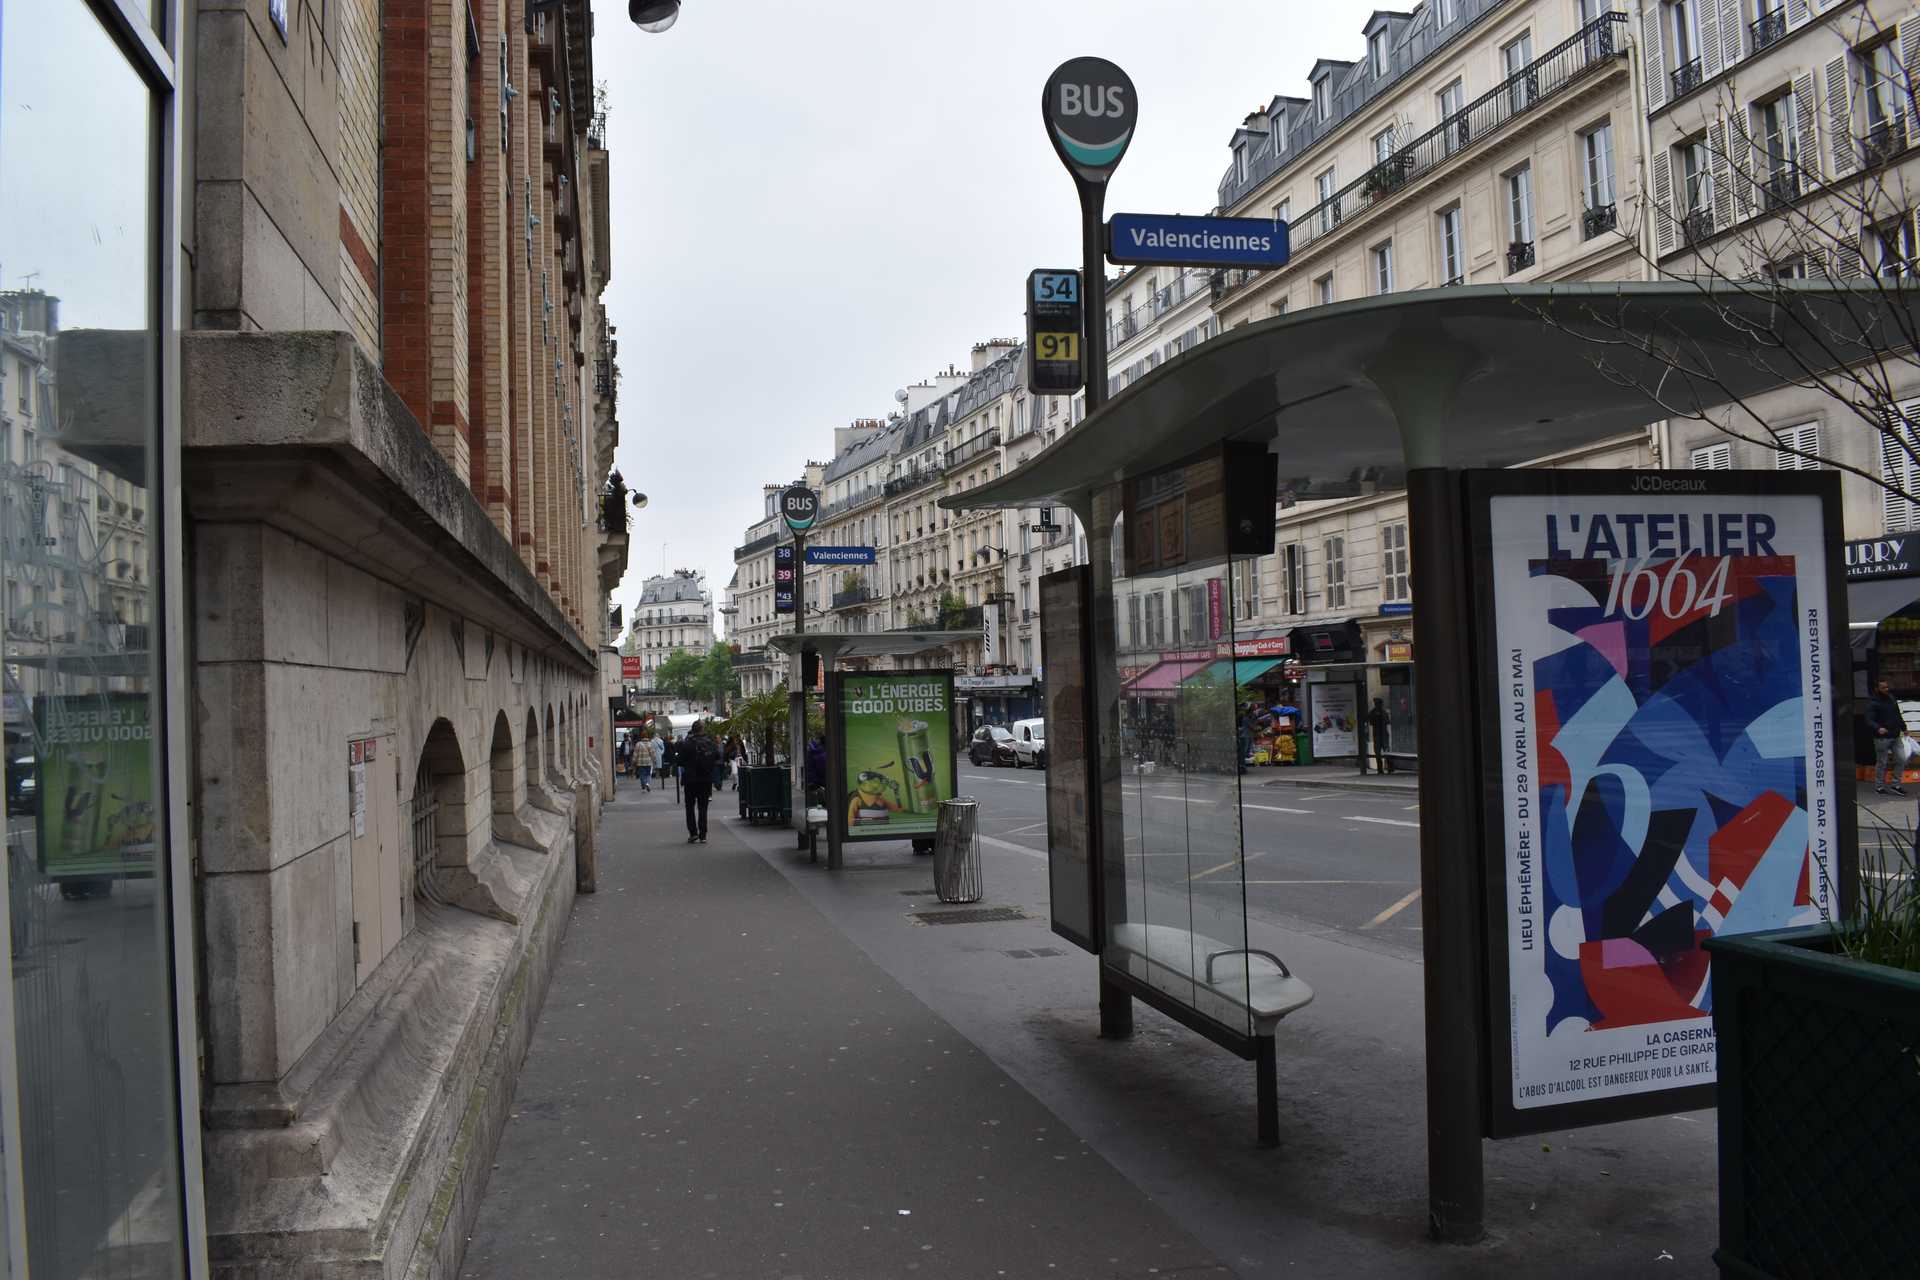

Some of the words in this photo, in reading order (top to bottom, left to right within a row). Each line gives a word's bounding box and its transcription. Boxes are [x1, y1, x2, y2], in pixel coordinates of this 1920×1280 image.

[1060, 83, 1124, 118] BUS
[1131, 227, 1271, 251] Valenciennes
[1041, 276, 1072, 299] 54
[1042, 335, 1071, 358] 91
[1631, 475, 1707, 491] JCDecaux
[787, 497, 813, 511] BUS
[1546, 514, 1777, 560] L'ATELIER
[777, 548, 791, 558] 38
[813, 551, 869, 560] Valenciennes
[777, 569, 791, 580] 39
[1603, 546, 1734, 621] 1664
[1512, 649, 1523, 678] MAI
[1808, 608, 1821, 702] RESTAURANT
[869, 682, 943, 699] L'ÉNERGIE
[1513, 684, 1524, 697] 21
[852, 700, 893, 714] GOOD
[1514, 702, 1525, 723] AU
[1515, 727, 1527, 769] AVRIL
[1814, 713, 1824, 787] TERRASSE
[1517, 774, 1528, 793] 29
[1518, 798, 1529, 818] DU
[1817, 799, 1826, 827] BAR
[1517, 830, 1532, 914] ÉPHÉMÈRE
[1522, 919, 1533, 950] LIEU
[1647, 1033, 1661, 1045] LA
[1569, 1059, 1581, 1071] 12
[1583, 1055, 1606, 1069] RUE
[1609, 1048, 1659, 1066] PHILIPPE
[1662, 1046, 1678, 1059] DE
[1519, 1085, 1546, 1099] L'ABUS
[1548, 1079, 1585, 1095] D'ALCOOL
[1588, 1076, 1602, 1089] EST
[1604, 1070, 1649, 1086] DANGEREUX
[1651, 1066, 1672, 1080] POUR
[1674, 1065, 1685, 1077] LA
